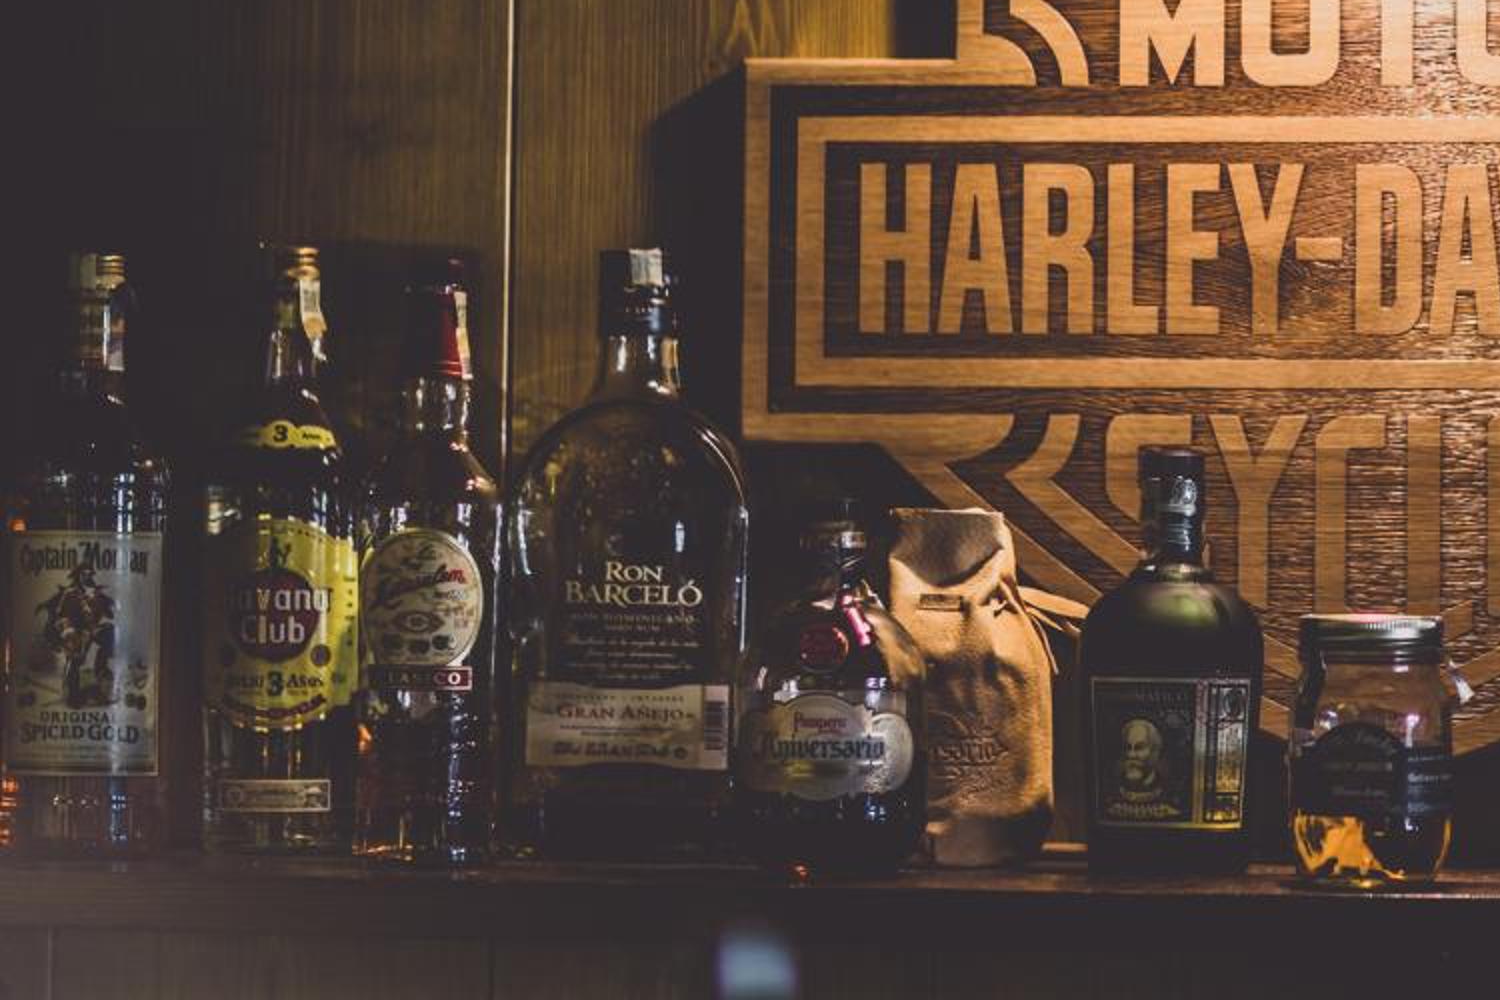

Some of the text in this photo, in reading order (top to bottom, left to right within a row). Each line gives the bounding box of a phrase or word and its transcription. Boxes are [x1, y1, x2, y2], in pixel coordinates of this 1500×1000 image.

[273, 425, 288, 443] 3
[78, 541, 148, 574] Moran
[605, 561, 664, 582] RON
[565, 578, 703, 608] BARCELÓ
[241, 614, 305, 644] Club
[267, 671, 283, 697] 3
[39, 711, 114, 724] ORIGINA
